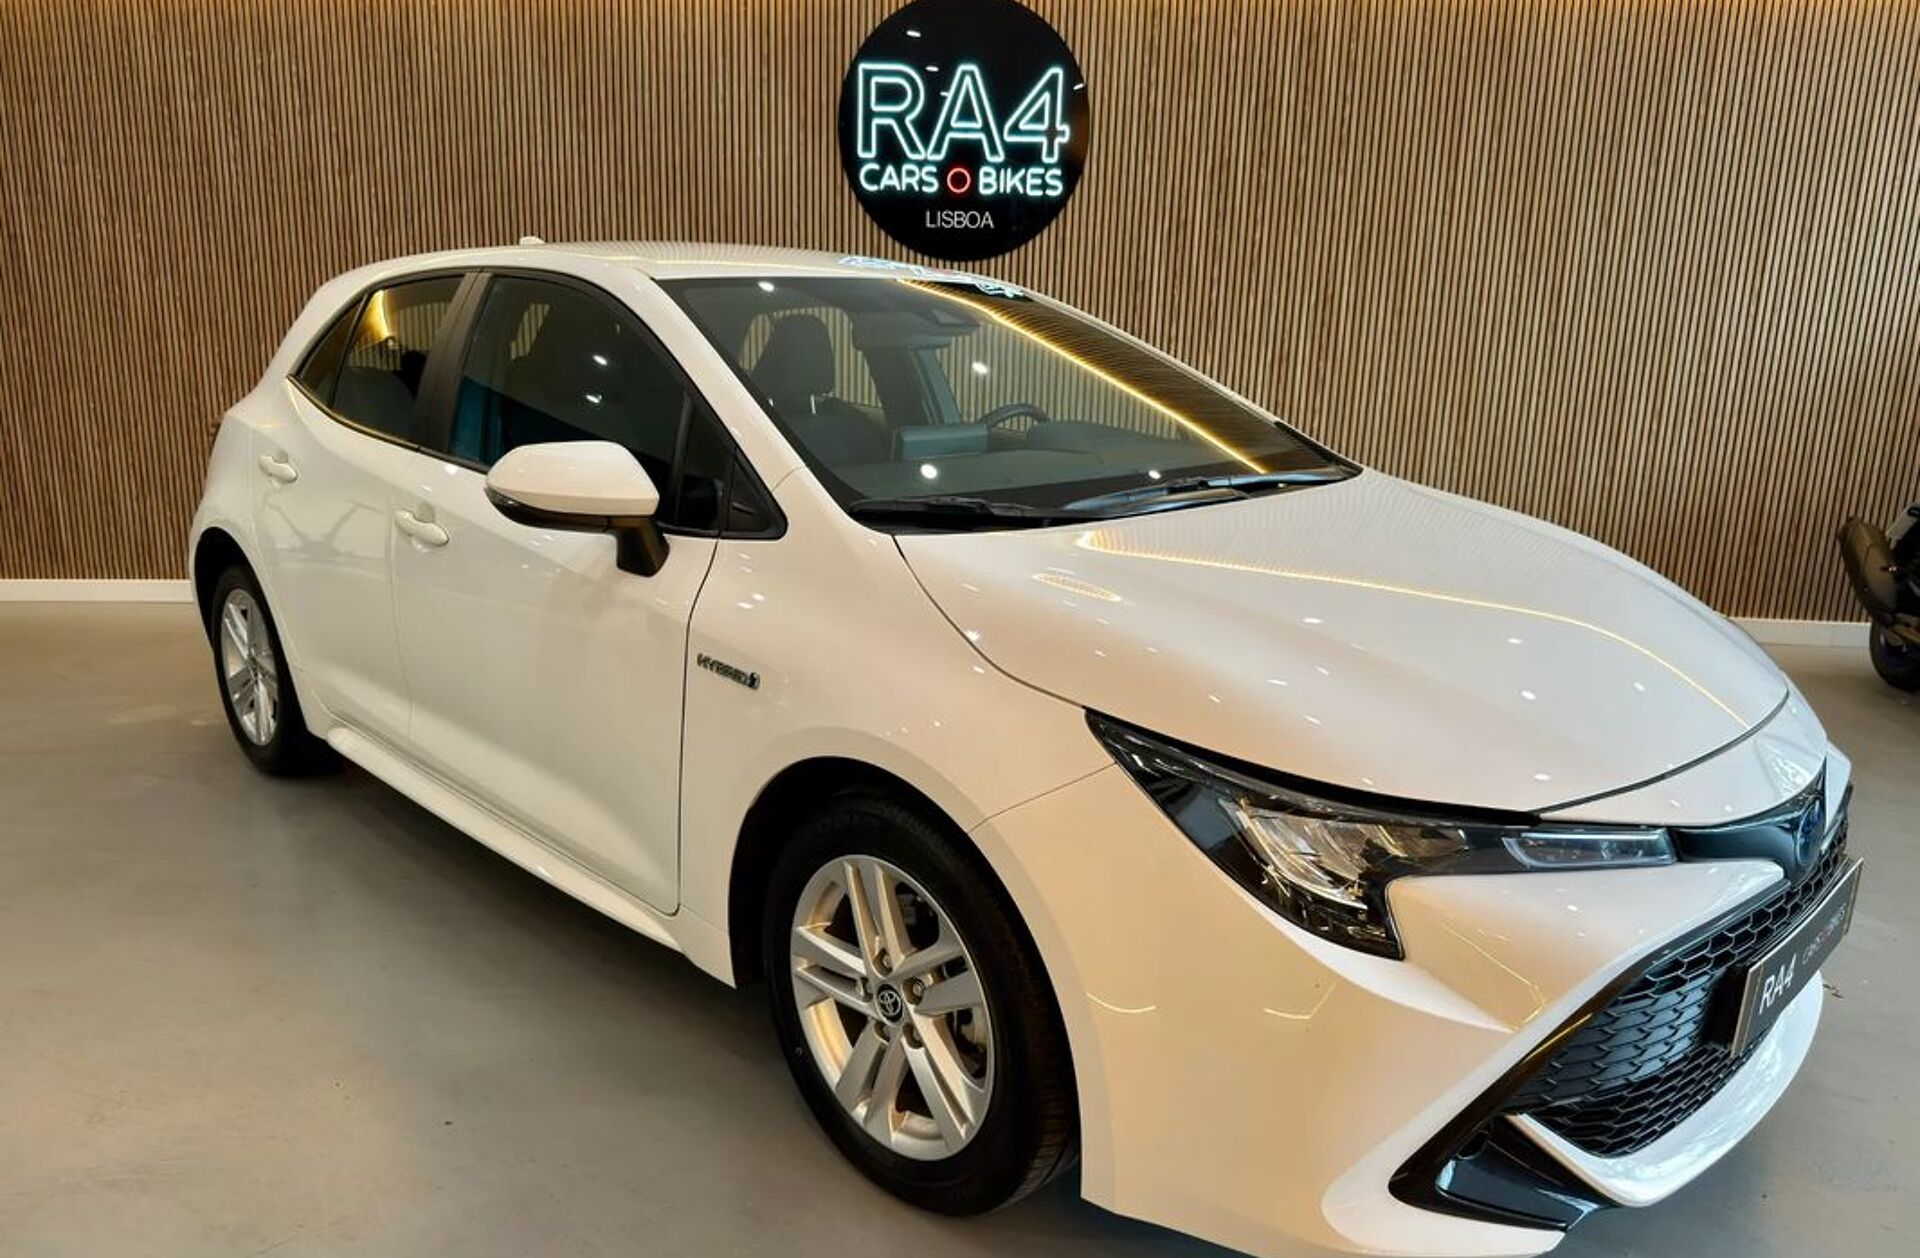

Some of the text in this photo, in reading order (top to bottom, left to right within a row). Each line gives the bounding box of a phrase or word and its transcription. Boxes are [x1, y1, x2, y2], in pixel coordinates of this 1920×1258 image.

[857, 63, 1070, 163] RA4
[859, 164, 1064, 196] CARS BIKES
[925, 211, 994, 229] LISBOA
[1759, 953, 1797, 1015] RA4
